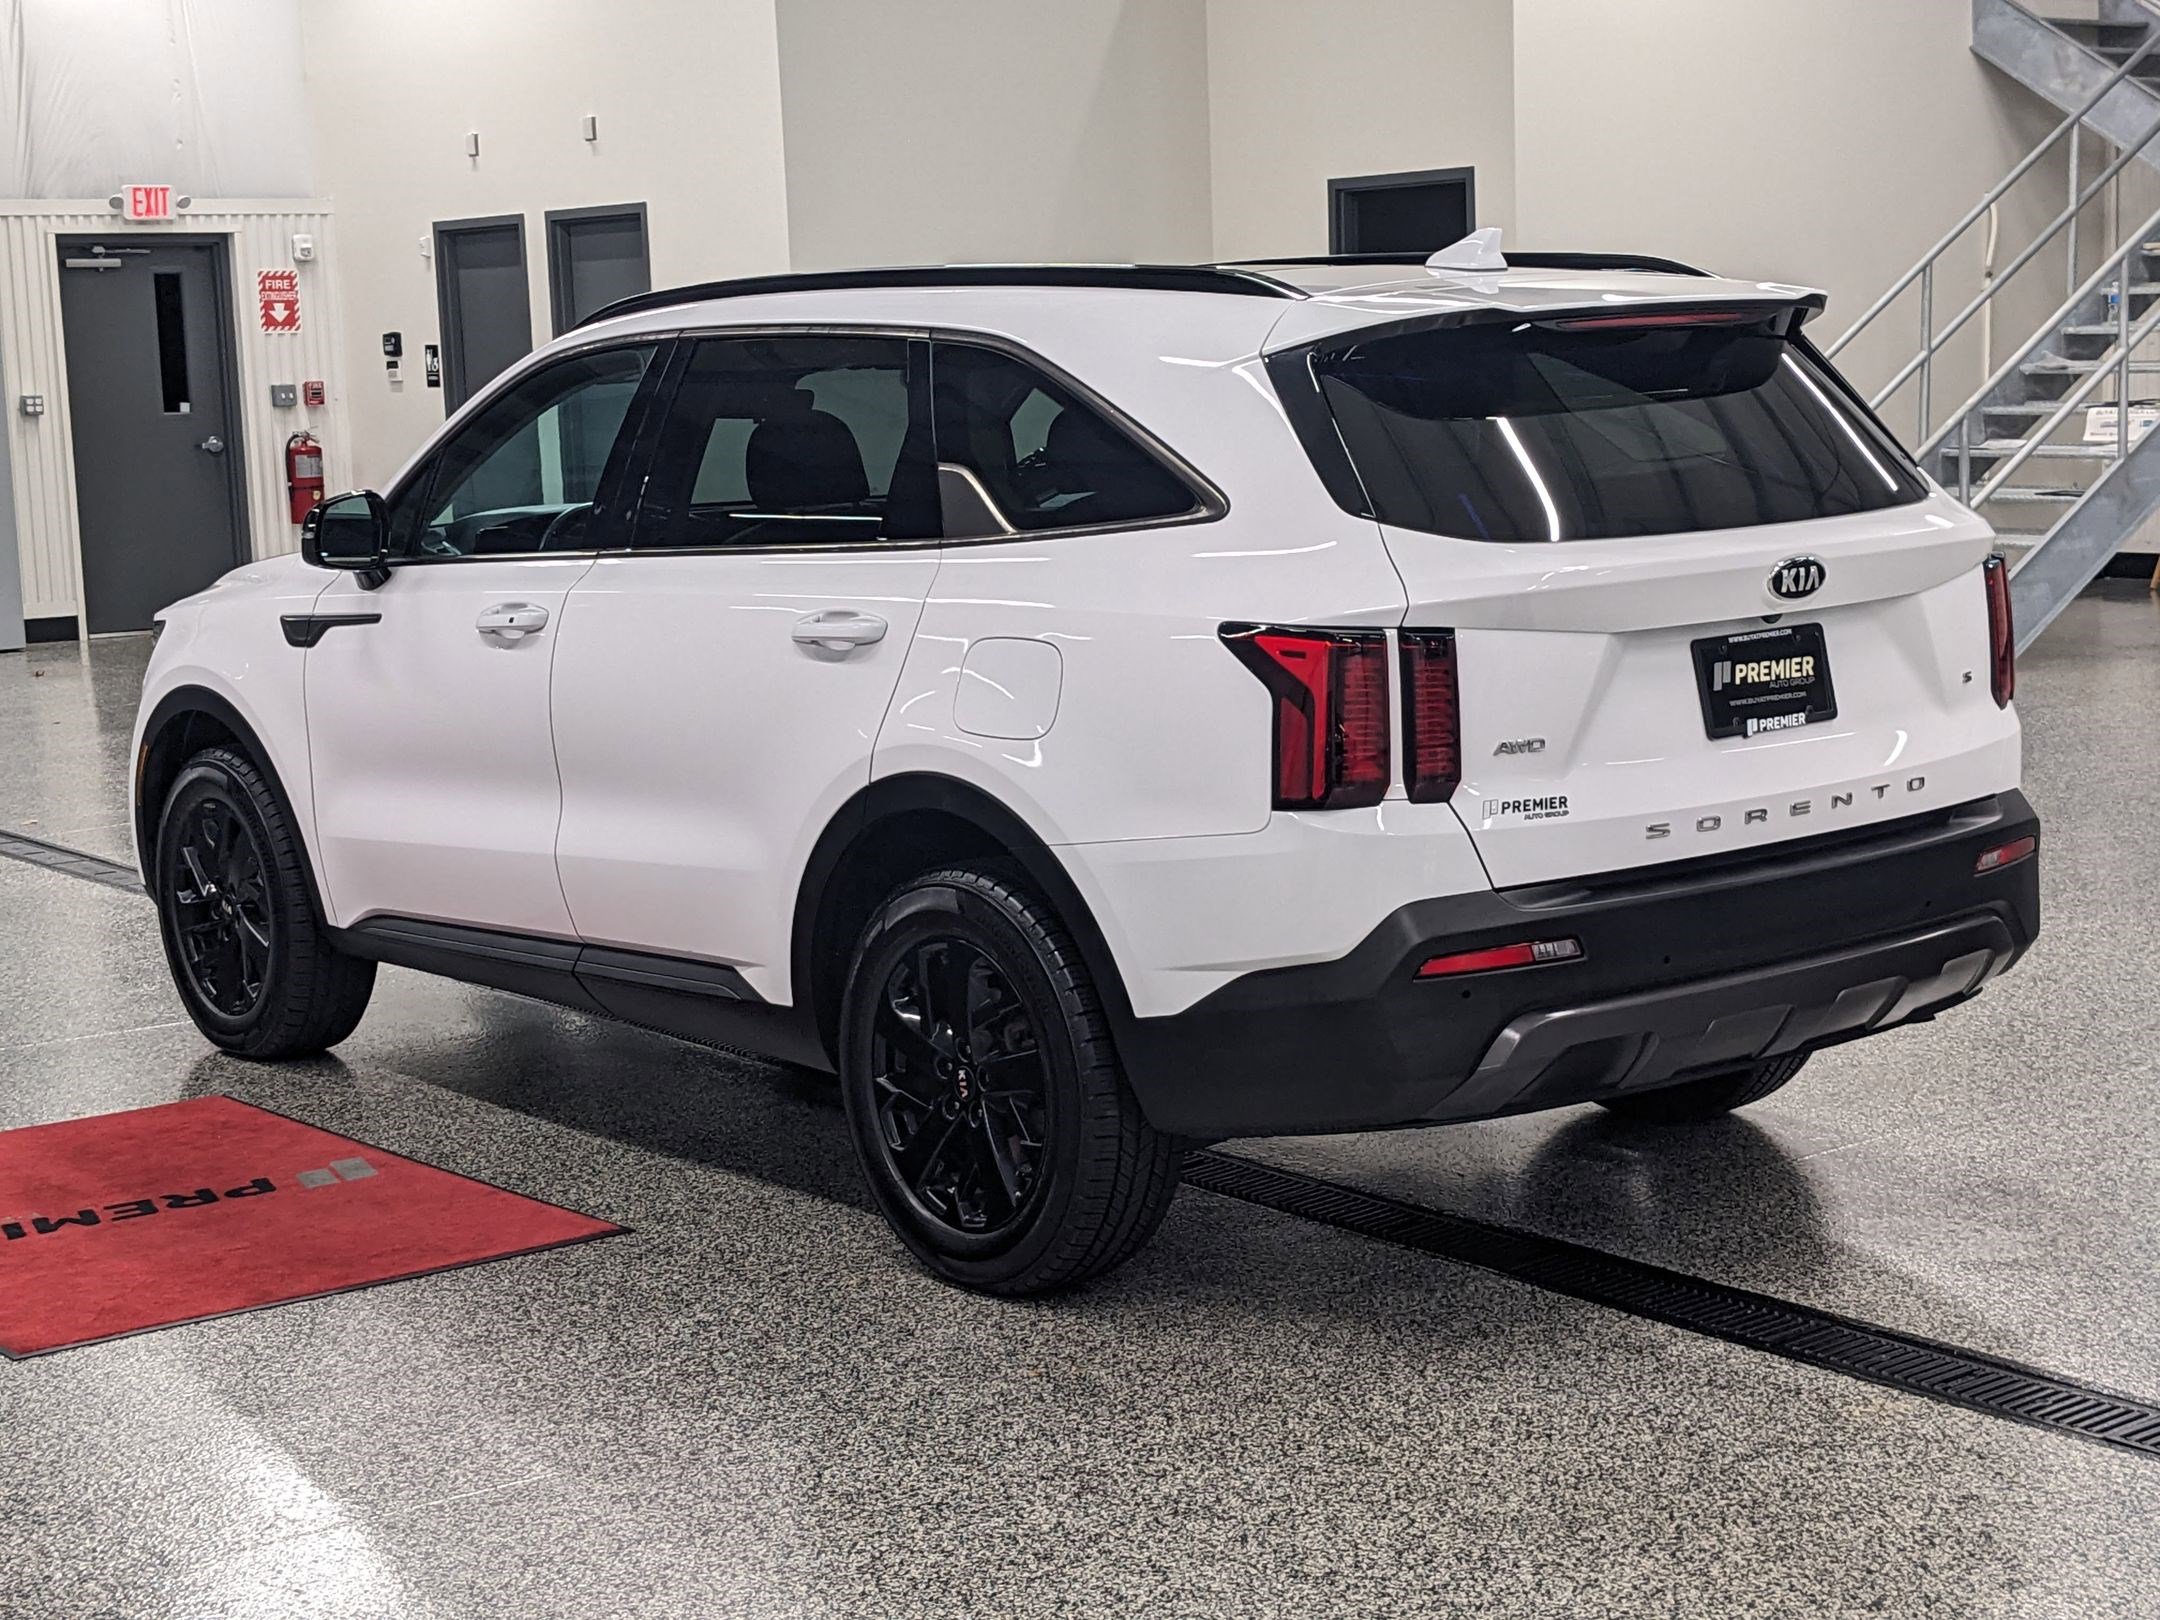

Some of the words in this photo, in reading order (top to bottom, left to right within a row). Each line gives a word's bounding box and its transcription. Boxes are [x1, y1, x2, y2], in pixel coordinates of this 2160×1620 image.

[132, 187, 170, 216] EXIT
[265, 279, 291, 290] FIRE
[1780, 565, 1820, 593] KIA
[1735, 656, 1814, 685] PREMIER
[1962, 670, 1972, 684] S
[1769, 679, 1789, 689] AUTO
[1789, 677, 1815, 687] GROUP
[1760, 712, 1806, 732] PREMIER
[1492, 738, 1546, 756] AWD
[1501, 796, 1568, 815] PREMIER
[1524, 812, 1543, 820] AUTO
[1544, 809, 1570, 818] GROUP
[1645, 776, 1926, 840] SORENTO
[958, 1069, 968, 1098] KIA
